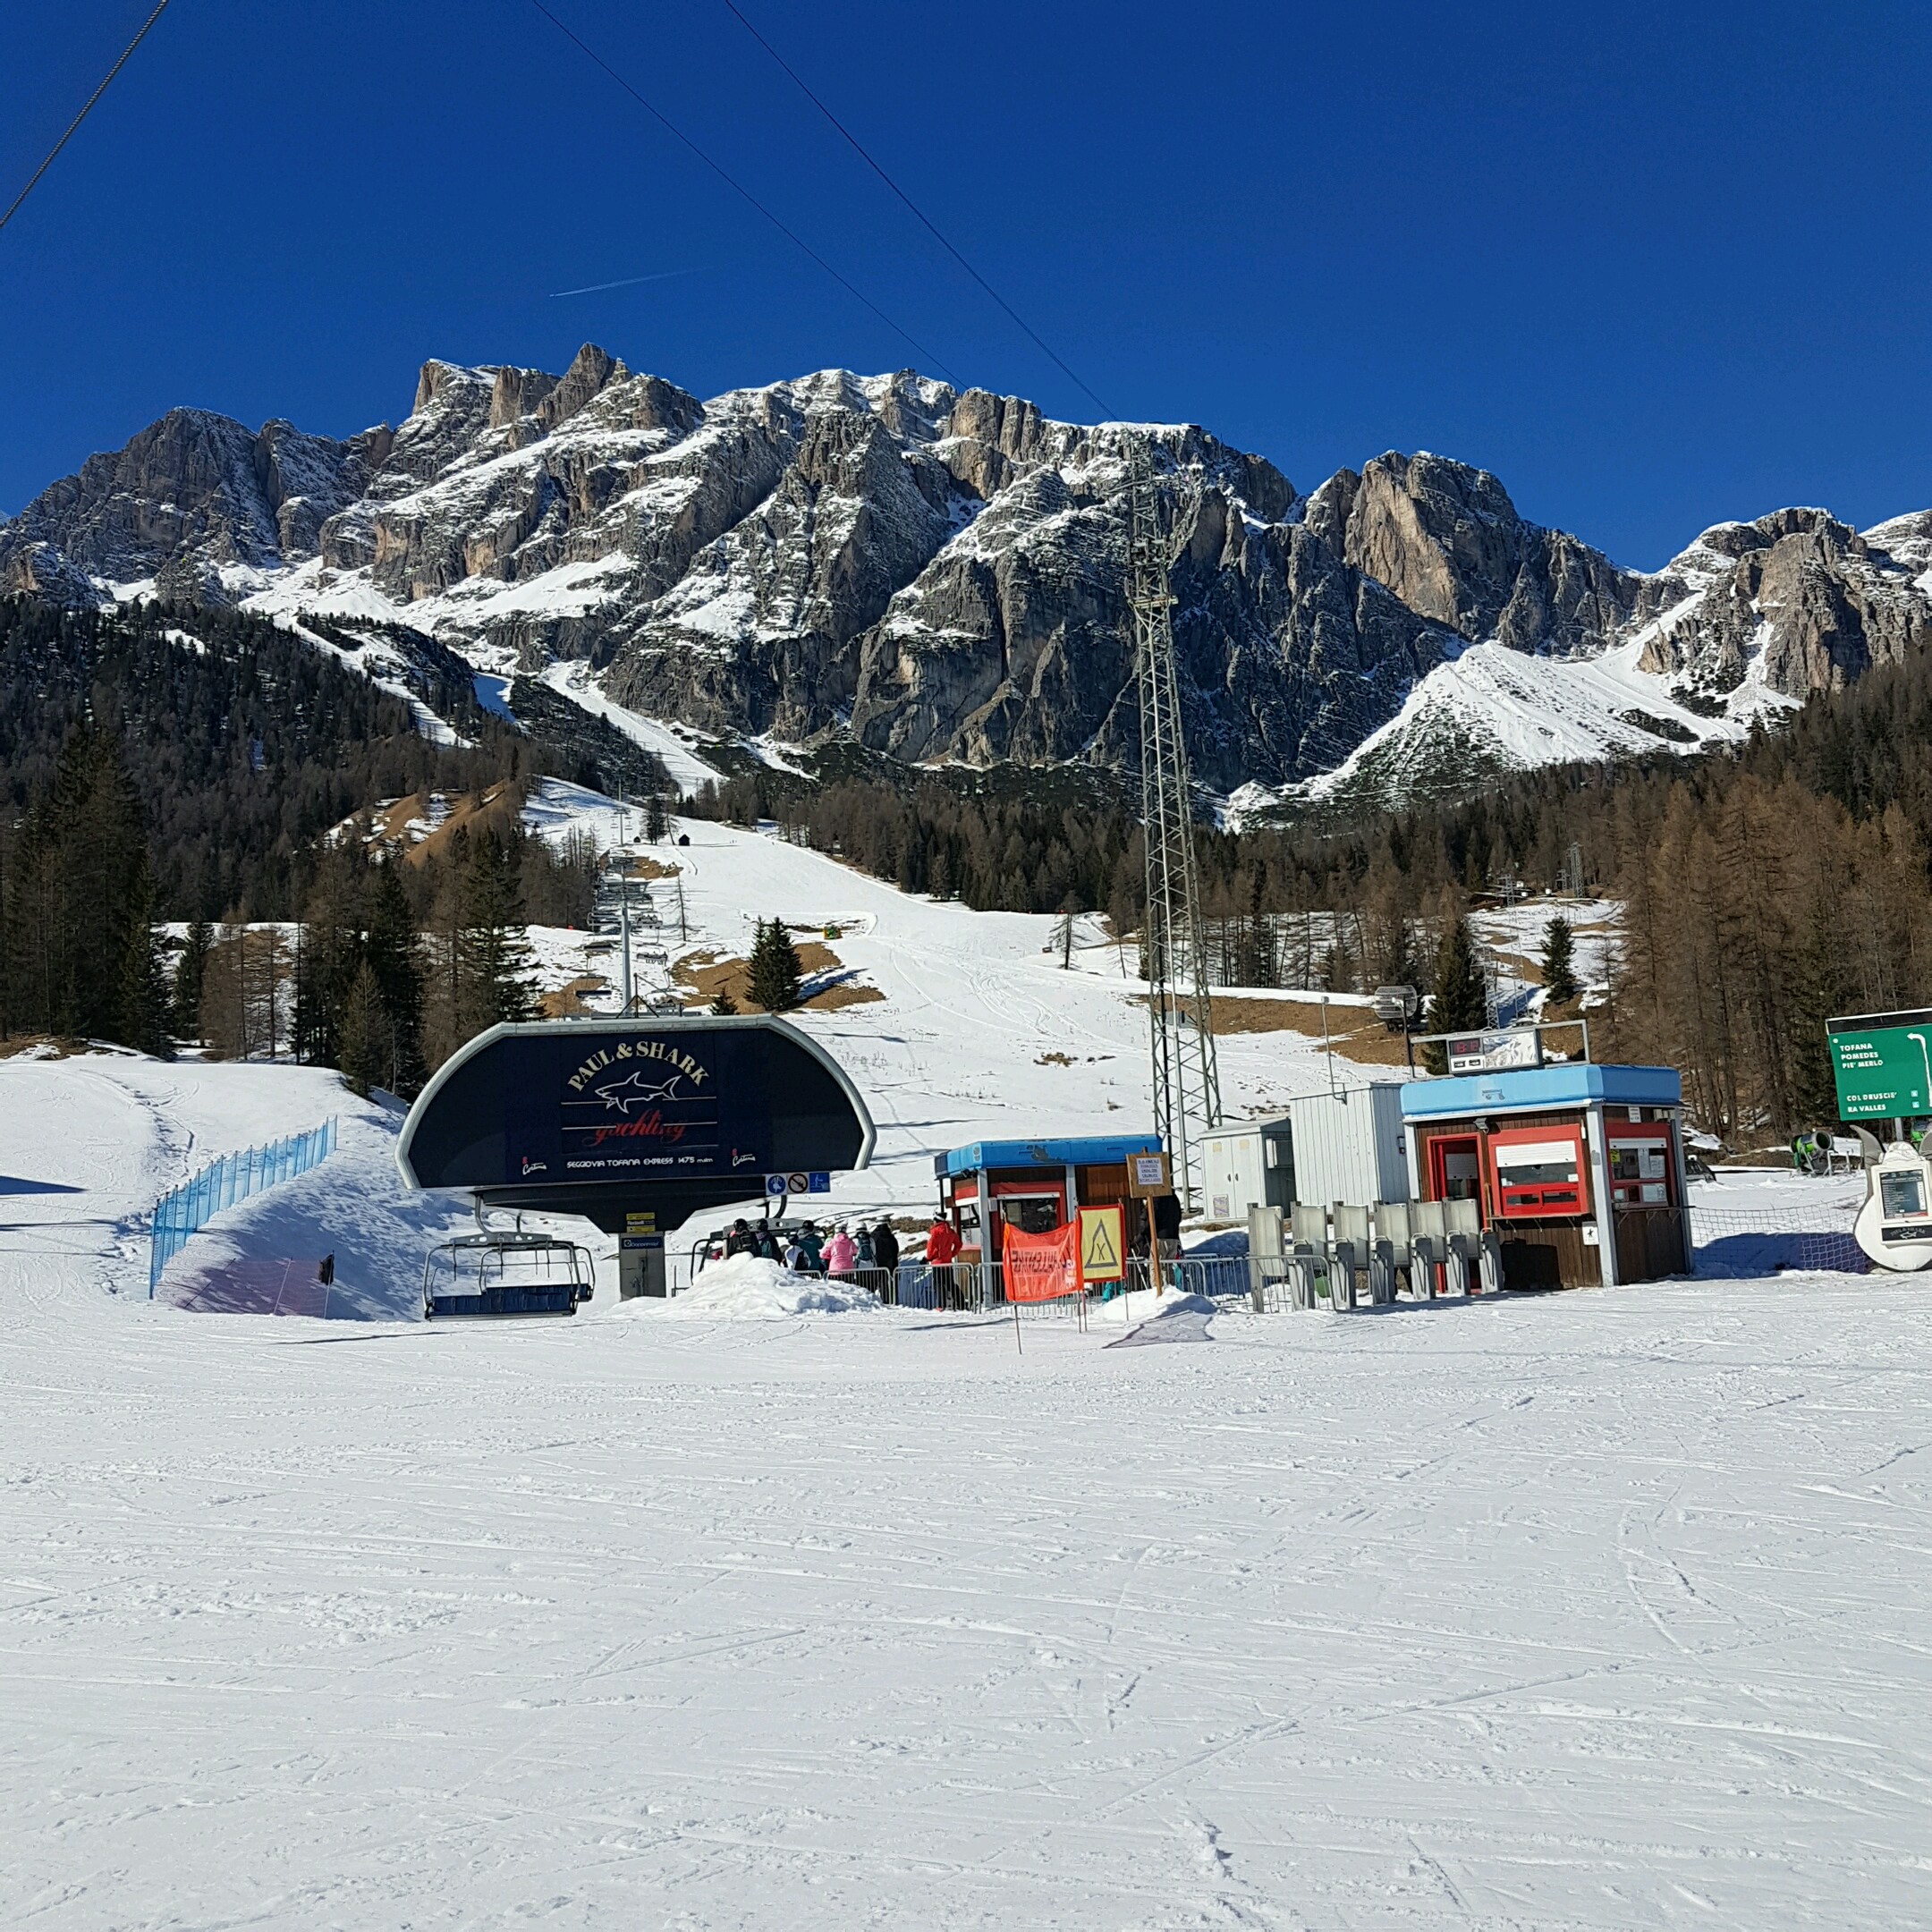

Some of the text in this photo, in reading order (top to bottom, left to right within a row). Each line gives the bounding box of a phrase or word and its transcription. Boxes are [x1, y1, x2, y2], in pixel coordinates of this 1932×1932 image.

[1839, 1043, 1873, 1052] TOFANA
[1841, 1052, 1878, 1060] POMEDES
[567, 1040, 709, 1092] PAUL & SHARK
[1858, 1060, 1884, 1068] MERLO
[606, 1158, 640, 1167] TOFANA
[643, 1157, 674, 1165] EXPRESS
